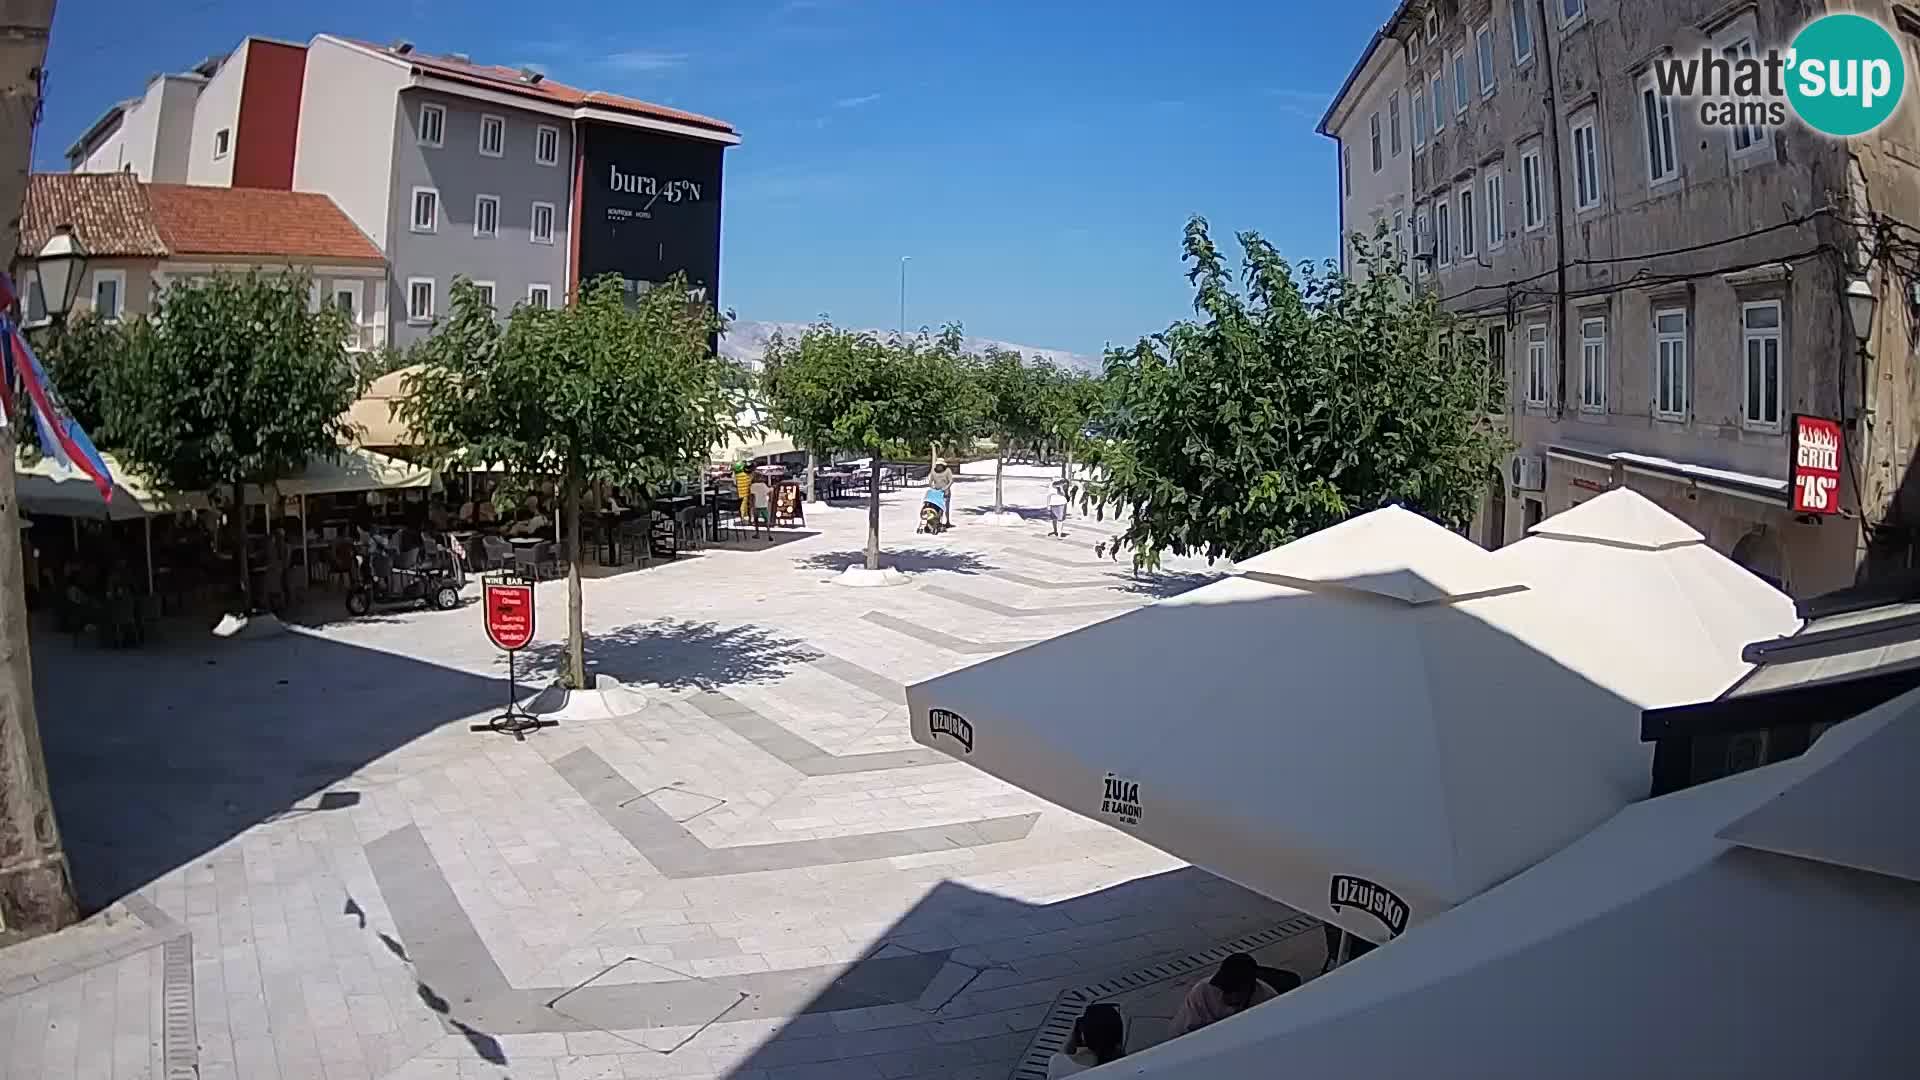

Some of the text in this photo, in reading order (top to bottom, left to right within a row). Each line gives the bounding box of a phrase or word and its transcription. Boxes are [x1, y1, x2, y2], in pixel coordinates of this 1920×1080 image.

[610, 164, 656, 196] bura
[1798, 446, 1838, 471] GRILL
[485, 577, 503, 585] WINE
[506, 577, 523, 585] BAR
[933, 711, 970, 743] Ožujsko
[1101, 800, 1109, 812] JE
[1337, 878, 1403, 928] Ožujsko
